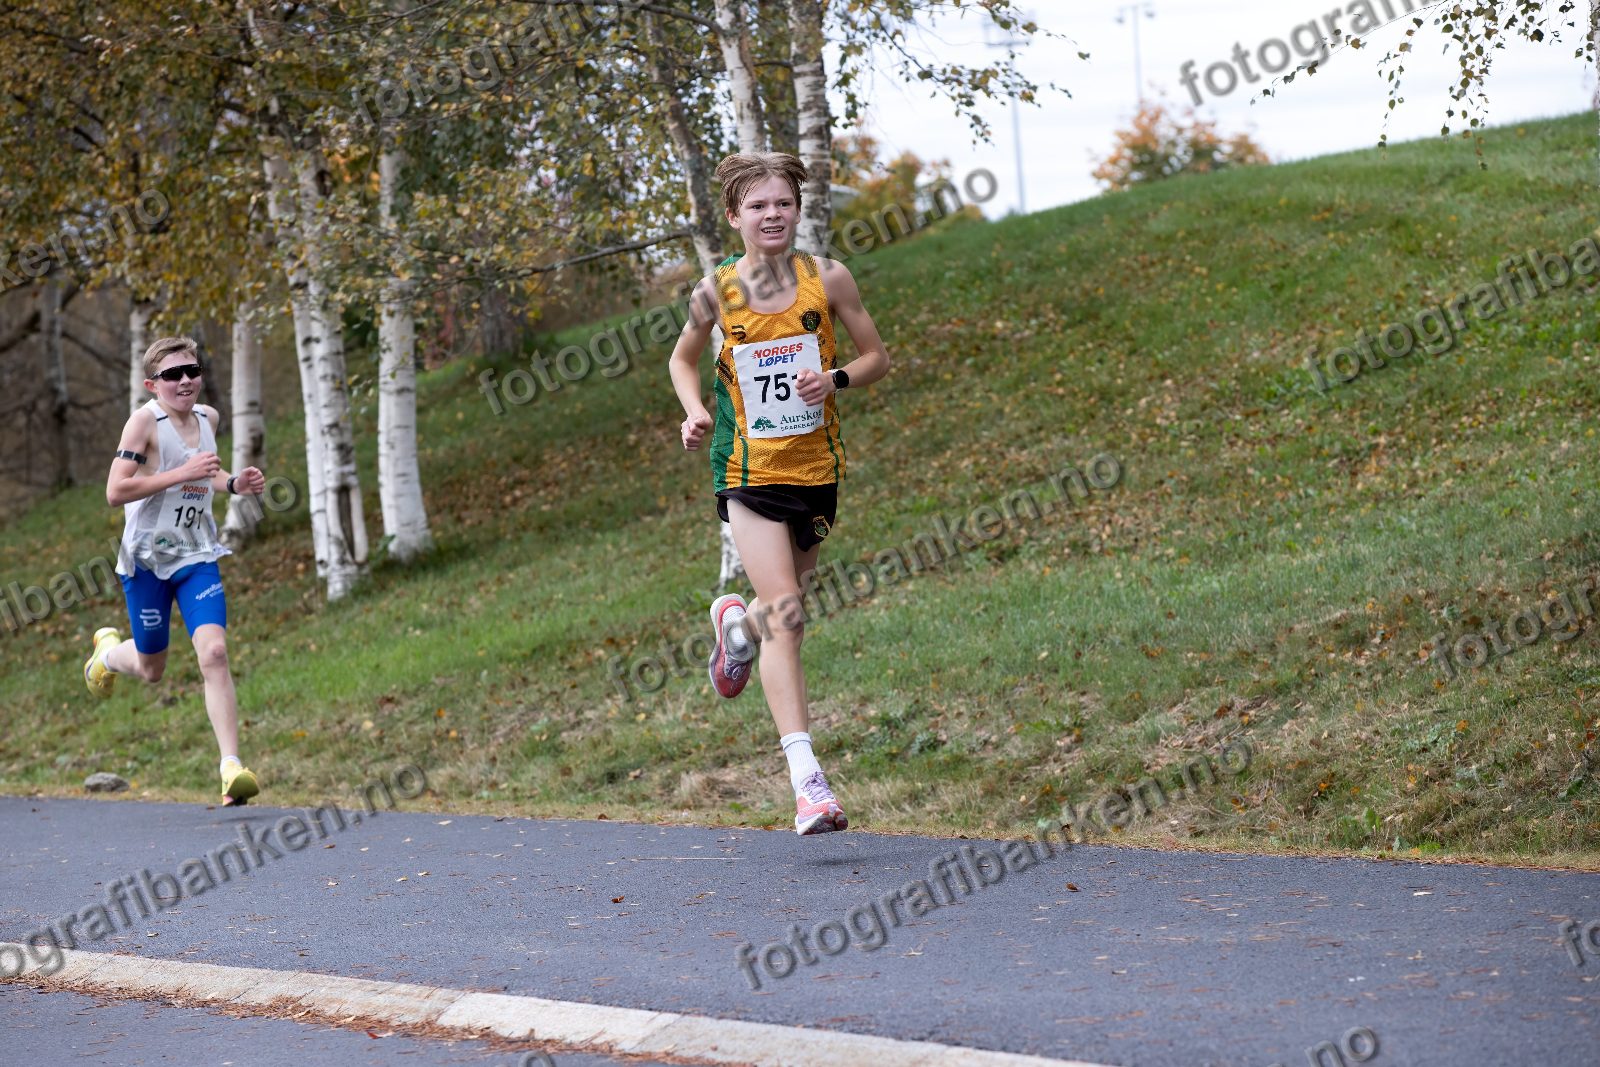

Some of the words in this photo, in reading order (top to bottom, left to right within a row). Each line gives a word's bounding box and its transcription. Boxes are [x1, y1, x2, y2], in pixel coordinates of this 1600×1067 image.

[752, 342, 804, 359] NORGES
[758, 353, 796, 368] LØPET
[181, 484, 209, 495] NORGES
[182, 492, 205, 502] LØPET
